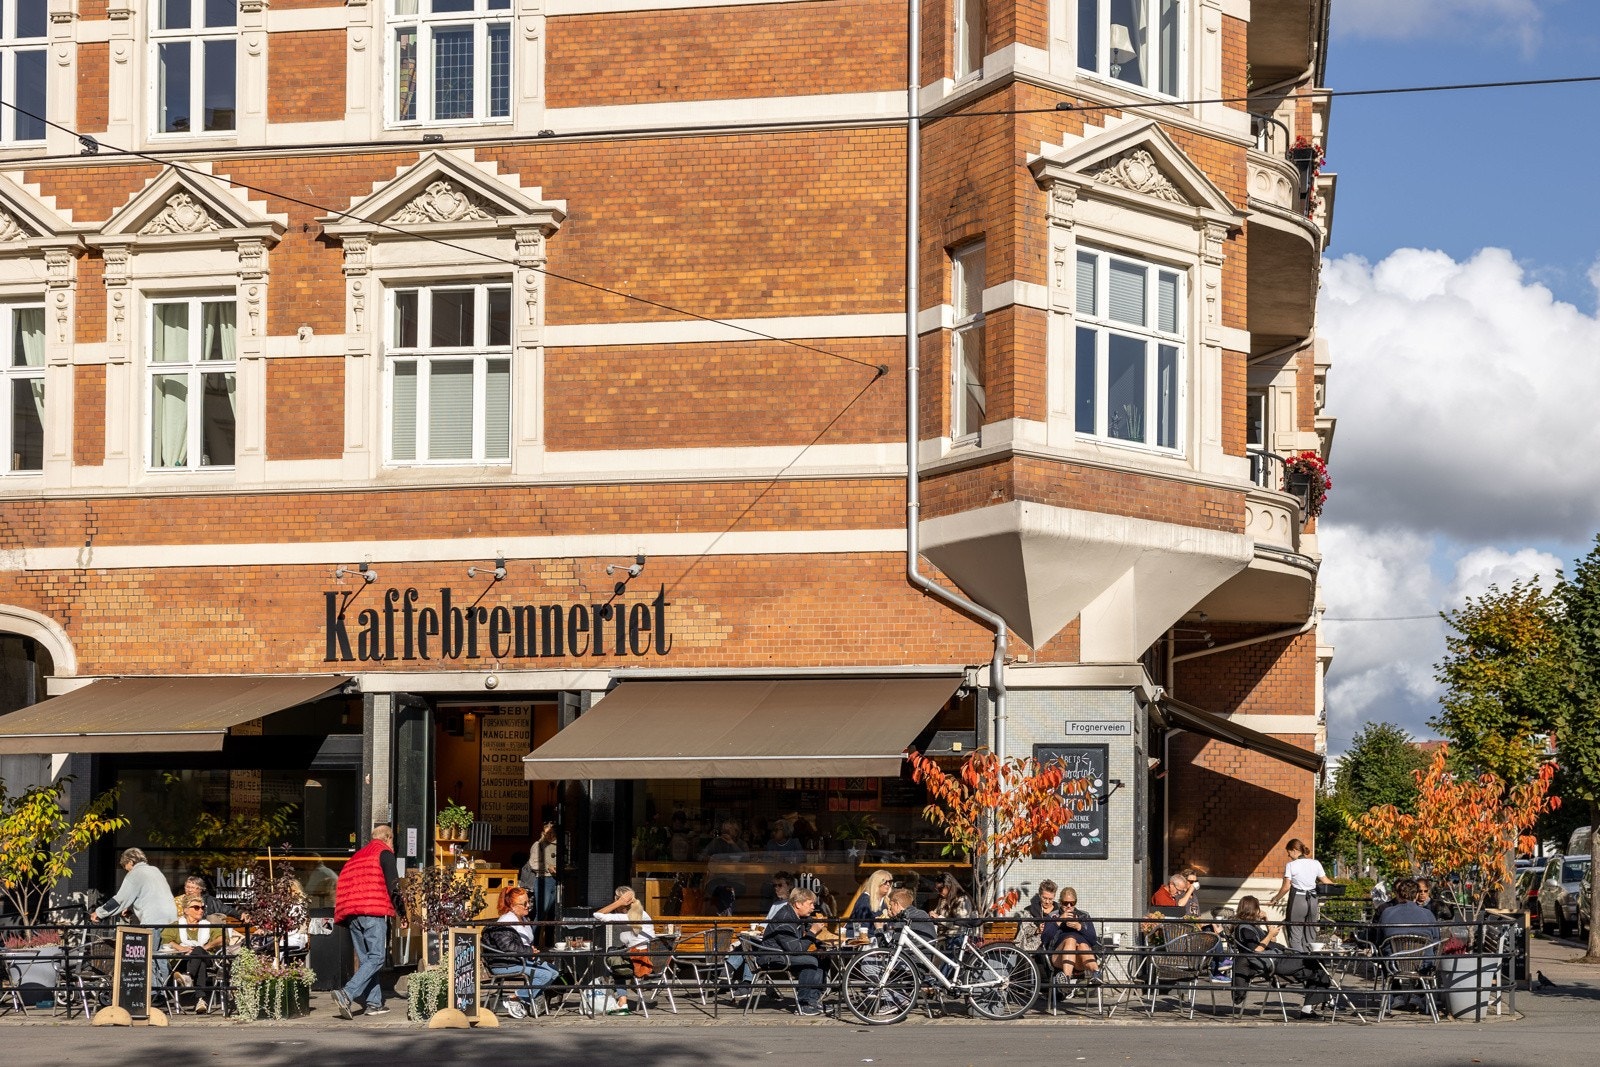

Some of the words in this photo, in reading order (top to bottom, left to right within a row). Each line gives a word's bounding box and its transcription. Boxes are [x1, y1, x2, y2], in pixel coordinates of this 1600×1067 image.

[324, 582, 672, 662] Kaffebrenneriet
[499, 706, 529, 715] SEBY
[1071, 723, 1125, 732] Frognerveien
[483, 731, 529, 739] MANGLERUD
[482, 754, 523, 763] NORDL
[230, 780, 261, 790] BJØLSEN
[481, 778, 528, 787] SANDSTUVEIEN
[481, 790, 498, 798] LILLE
[498, 790, 529, 799] LANGERUD
[216, 867, 255, 888] Kaffe
[794, 872, 821, 894] ffe
